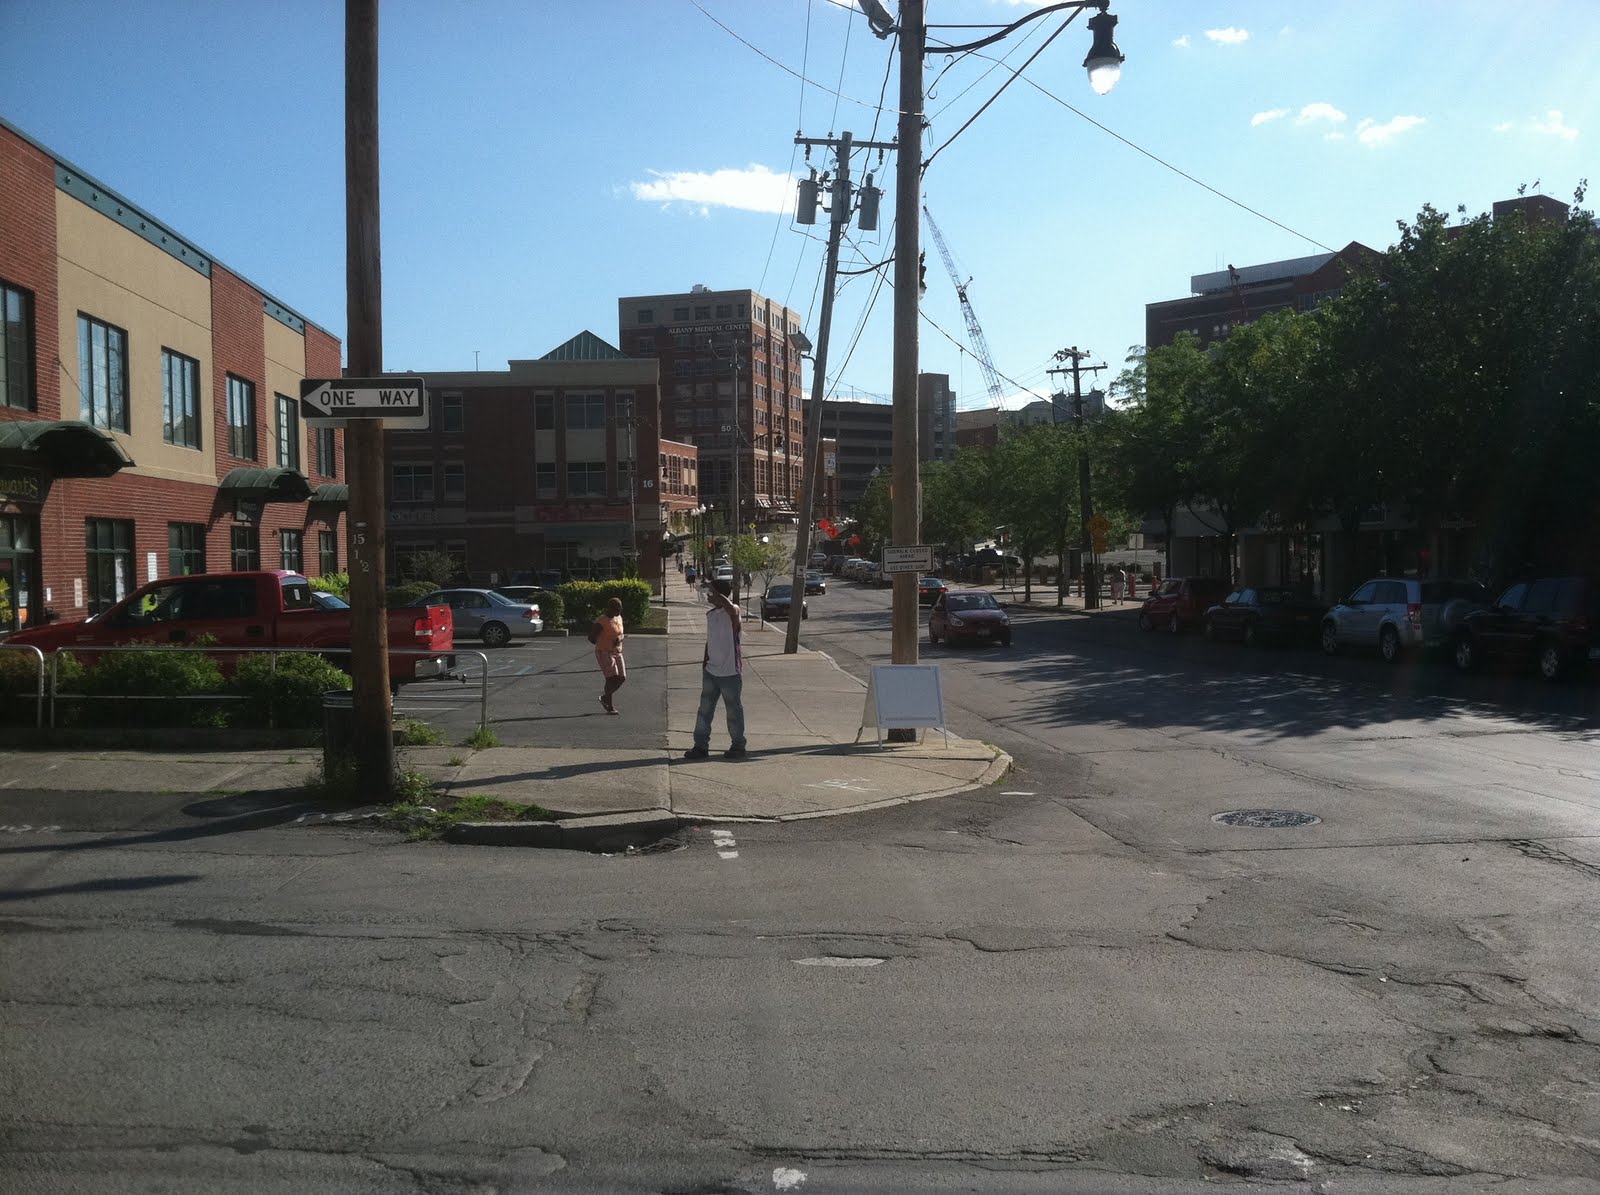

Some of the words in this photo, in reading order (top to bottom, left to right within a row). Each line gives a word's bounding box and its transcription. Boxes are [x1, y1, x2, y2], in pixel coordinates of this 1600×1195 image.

[694, 325, 722, 333] MEDICAL
[725, 323, 750, 331] CENTER
[320, 391, 356, 406] ONE
[379, 390, 414, 405] WAY
[643, 480, 654, 488] 16
[352, 533, 365, 545] 15
